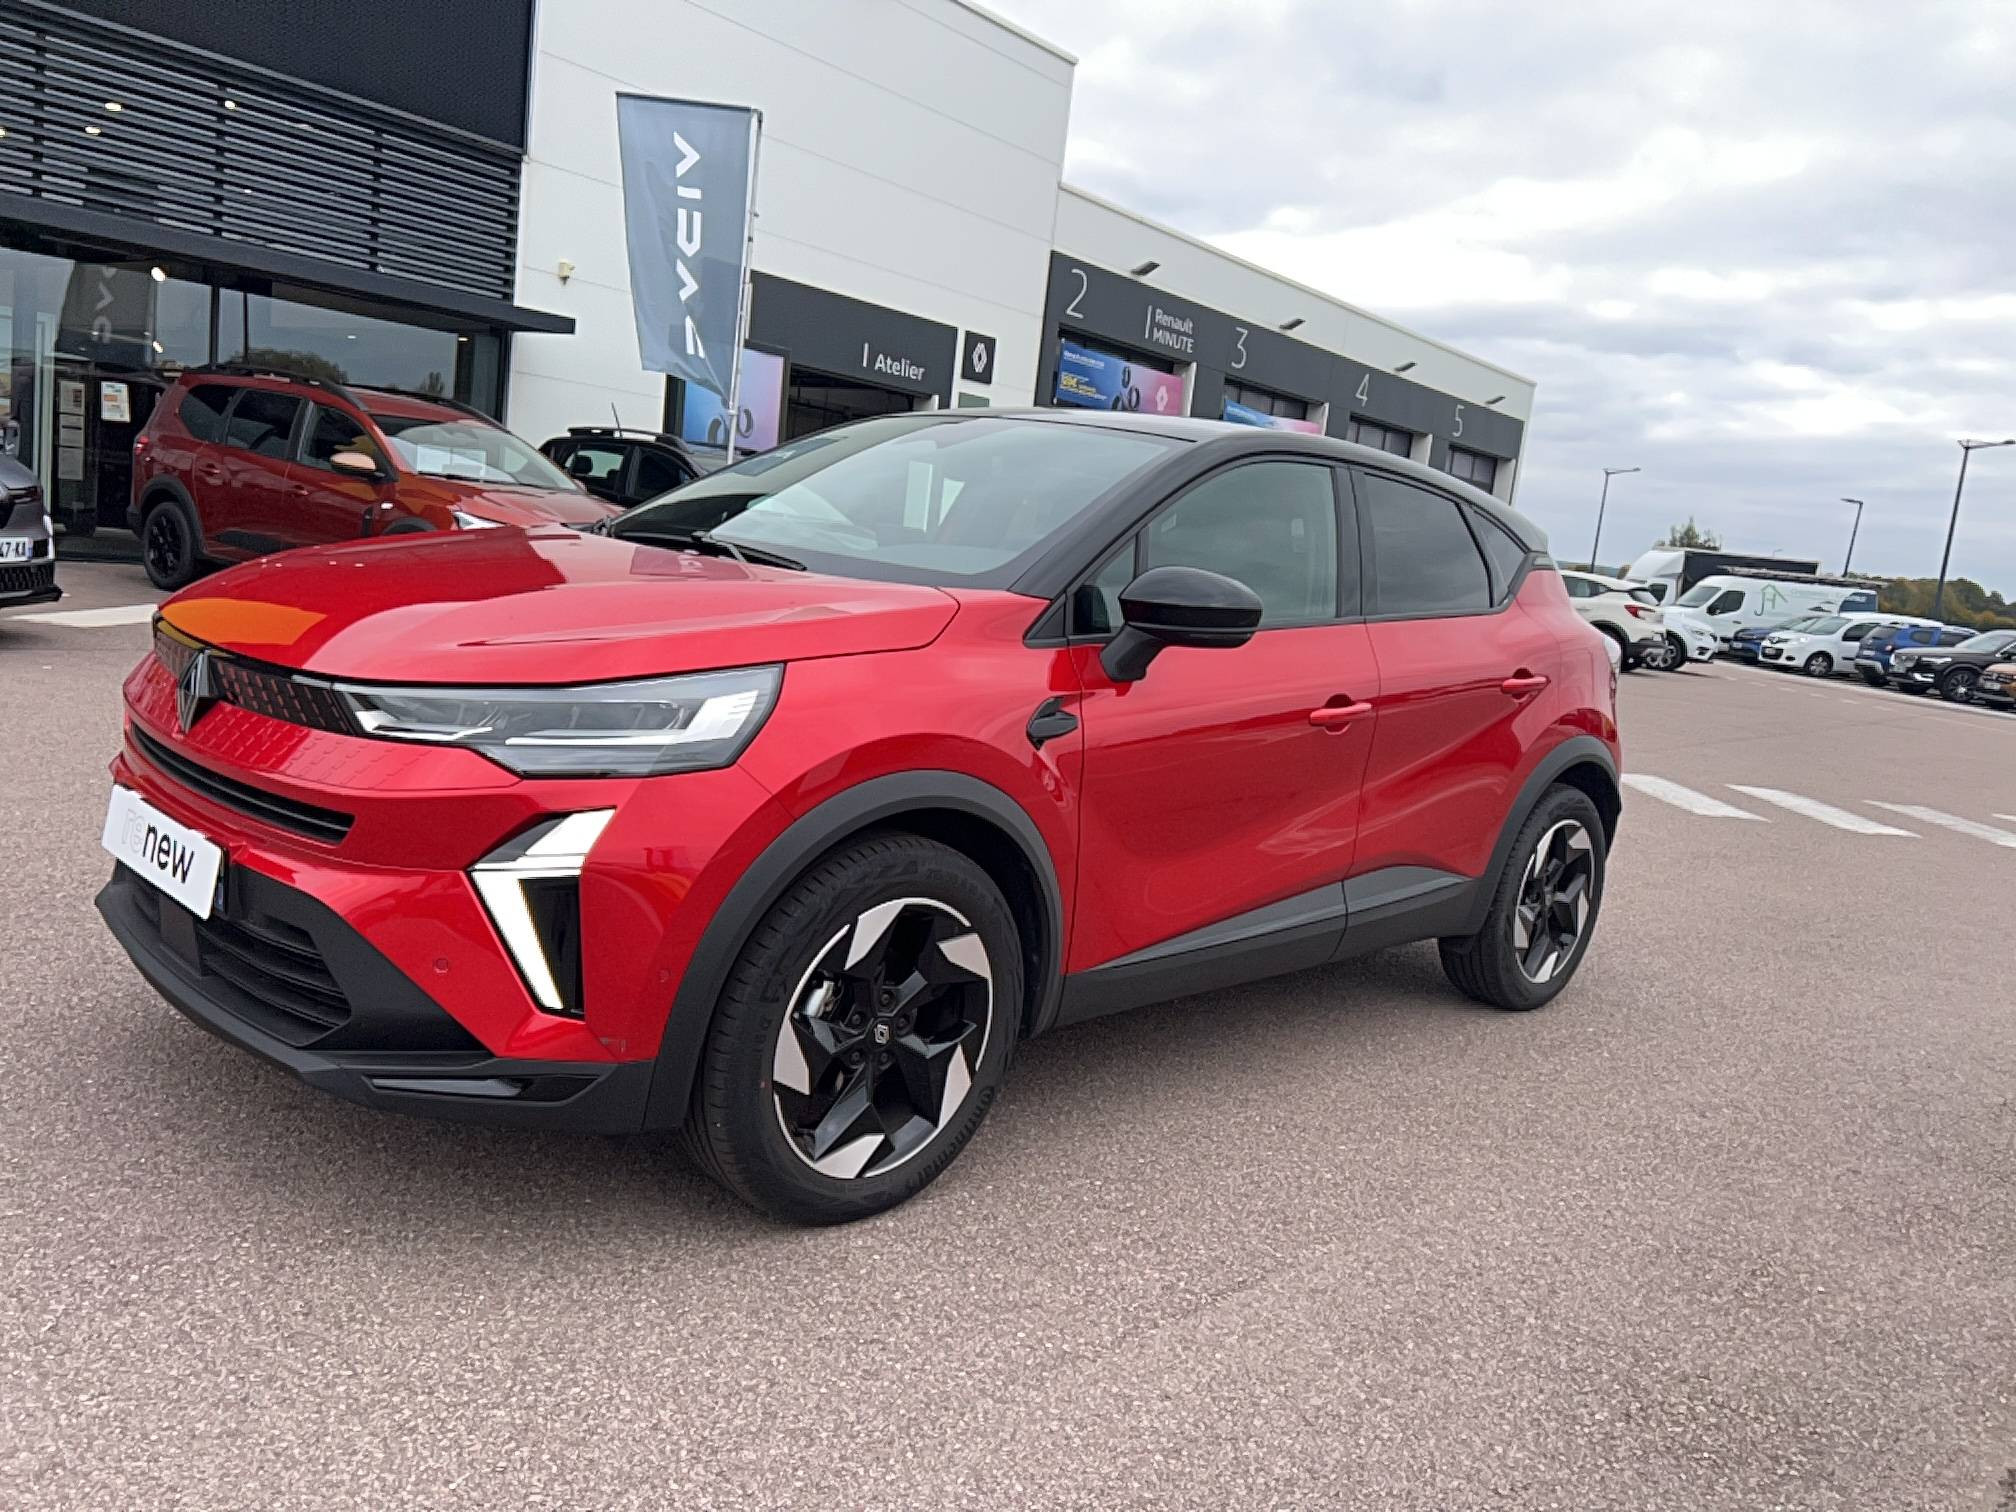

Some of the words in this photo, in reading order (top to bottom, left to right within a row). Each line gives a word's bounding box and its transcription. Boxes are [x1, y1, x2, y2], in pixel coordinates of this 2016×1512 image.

[1066, 268, 1088, 319] 2
[1154, 308, 1194, 335] Renault
[1152, 327, 1195, 354] MINUTE
[1231, 327, 1248, 369] 3
[874, 353, 925, 381] Atelier
[1355, 373, 1370, 408] 4
[1453, 404, 1463, 438] 5
